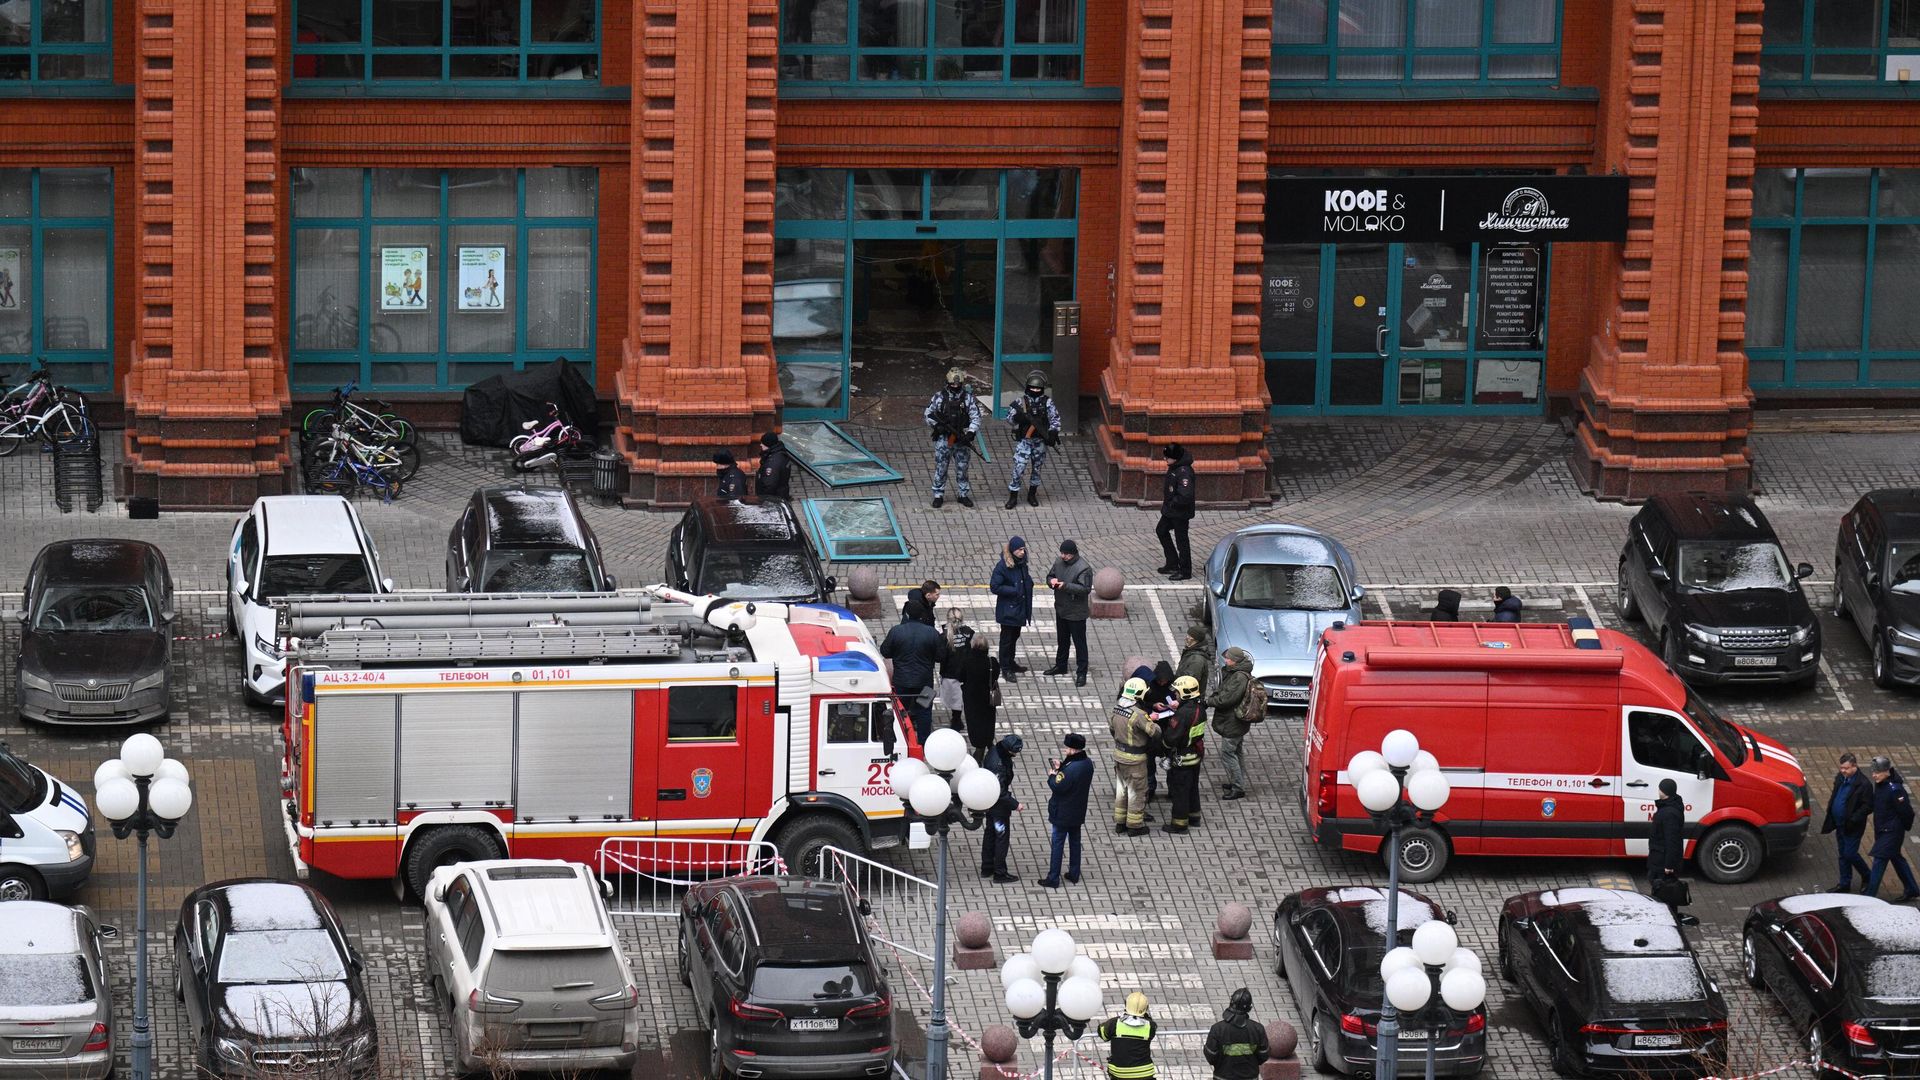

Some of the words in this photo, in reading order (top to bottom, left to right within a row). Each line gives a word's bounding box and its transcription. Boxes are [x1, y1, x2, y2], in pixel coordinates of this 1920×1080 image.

[1325, 190, 1388, 212] КОФЕ
[1392, 193, 1406, 210] &
[1324, 215, 1405, 232] MOLOKO
[1479, 212, 1570, 230] Химчистка
[1270, 279, 1293, 287] КОФЕ
[323, 672, 386, 683] АЦ-3,2-40/4
[439, 671, 489, 681] ТЕЛЕФОН
[532, 669, 571, 681] 01,101
[1507, 778, 1552, 787] ТЕЛЕФОН
[1556, 779, 1586, 788] 01,101
[861, 786, 896, 796] МОСКВ
